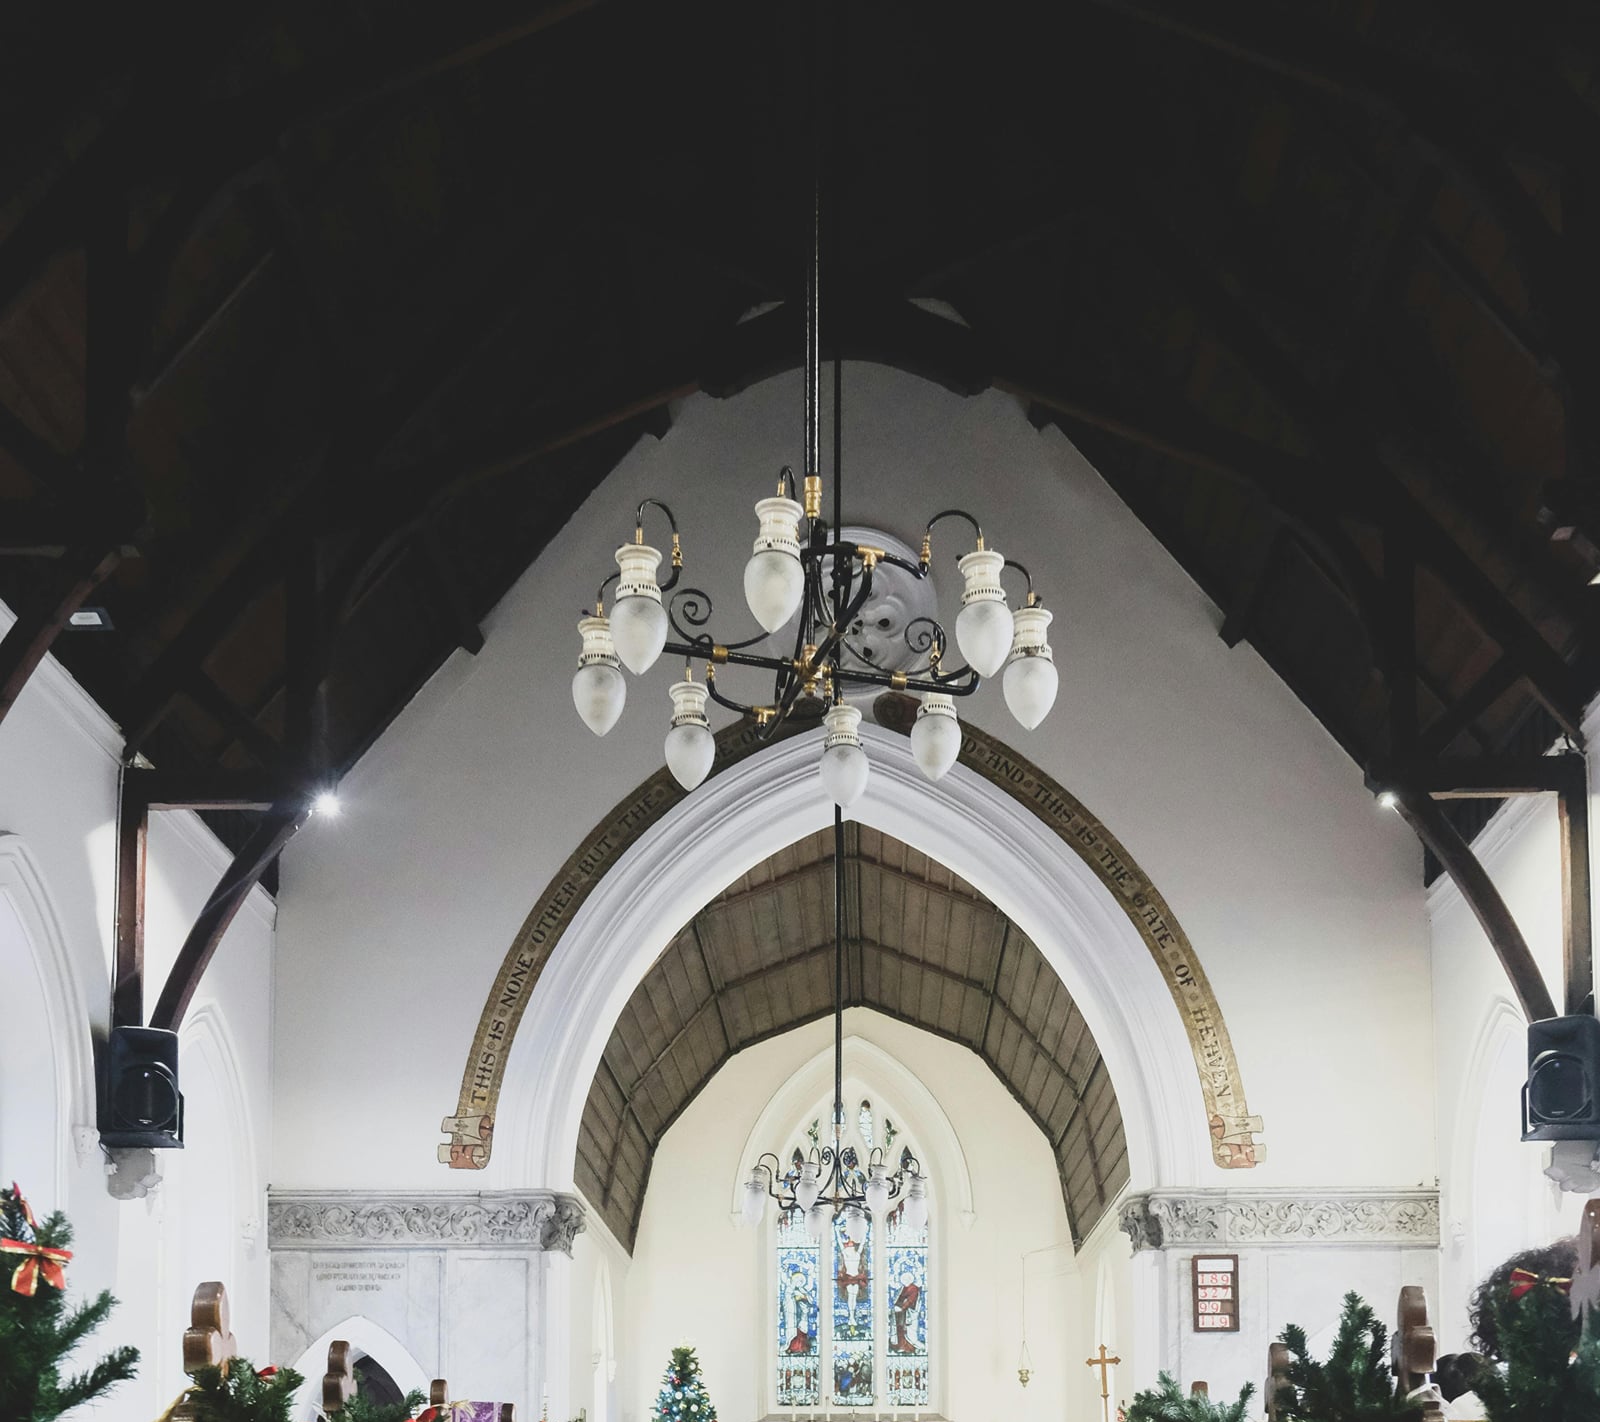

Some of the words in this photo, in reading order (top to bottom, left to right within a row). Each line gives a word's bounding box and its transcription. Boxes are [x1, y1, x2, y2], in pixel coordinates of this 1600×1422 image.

[470, 1051, 496, 1104] THIS
[488, 1019, 506, 1041] IS
[500, 952, 534, 1008] NONE
[531, 881, 578, 944] OTHER
[578, 835, 612, 876] BUT
[617, 793, 660, 830] THE
[986, 750, 1025, 783] AND
[1033, 783, 1075, 824] THIS
[1076, 825, 1098, 847] IS
[1101, 848, 1134, 888] THE
[1132, 893, 1175, 949] GATE
[1174, 964, 1197, 987] OF
[1192, 1007, 1231, 1098] HEAVEN
[1201, 1273, 1229, 1285] 189
[1200, 1286, 1229, 1298] 327
[1200, 1302, 1219, 1313] 99
[1201, 1315, 1228, 1327] 119
